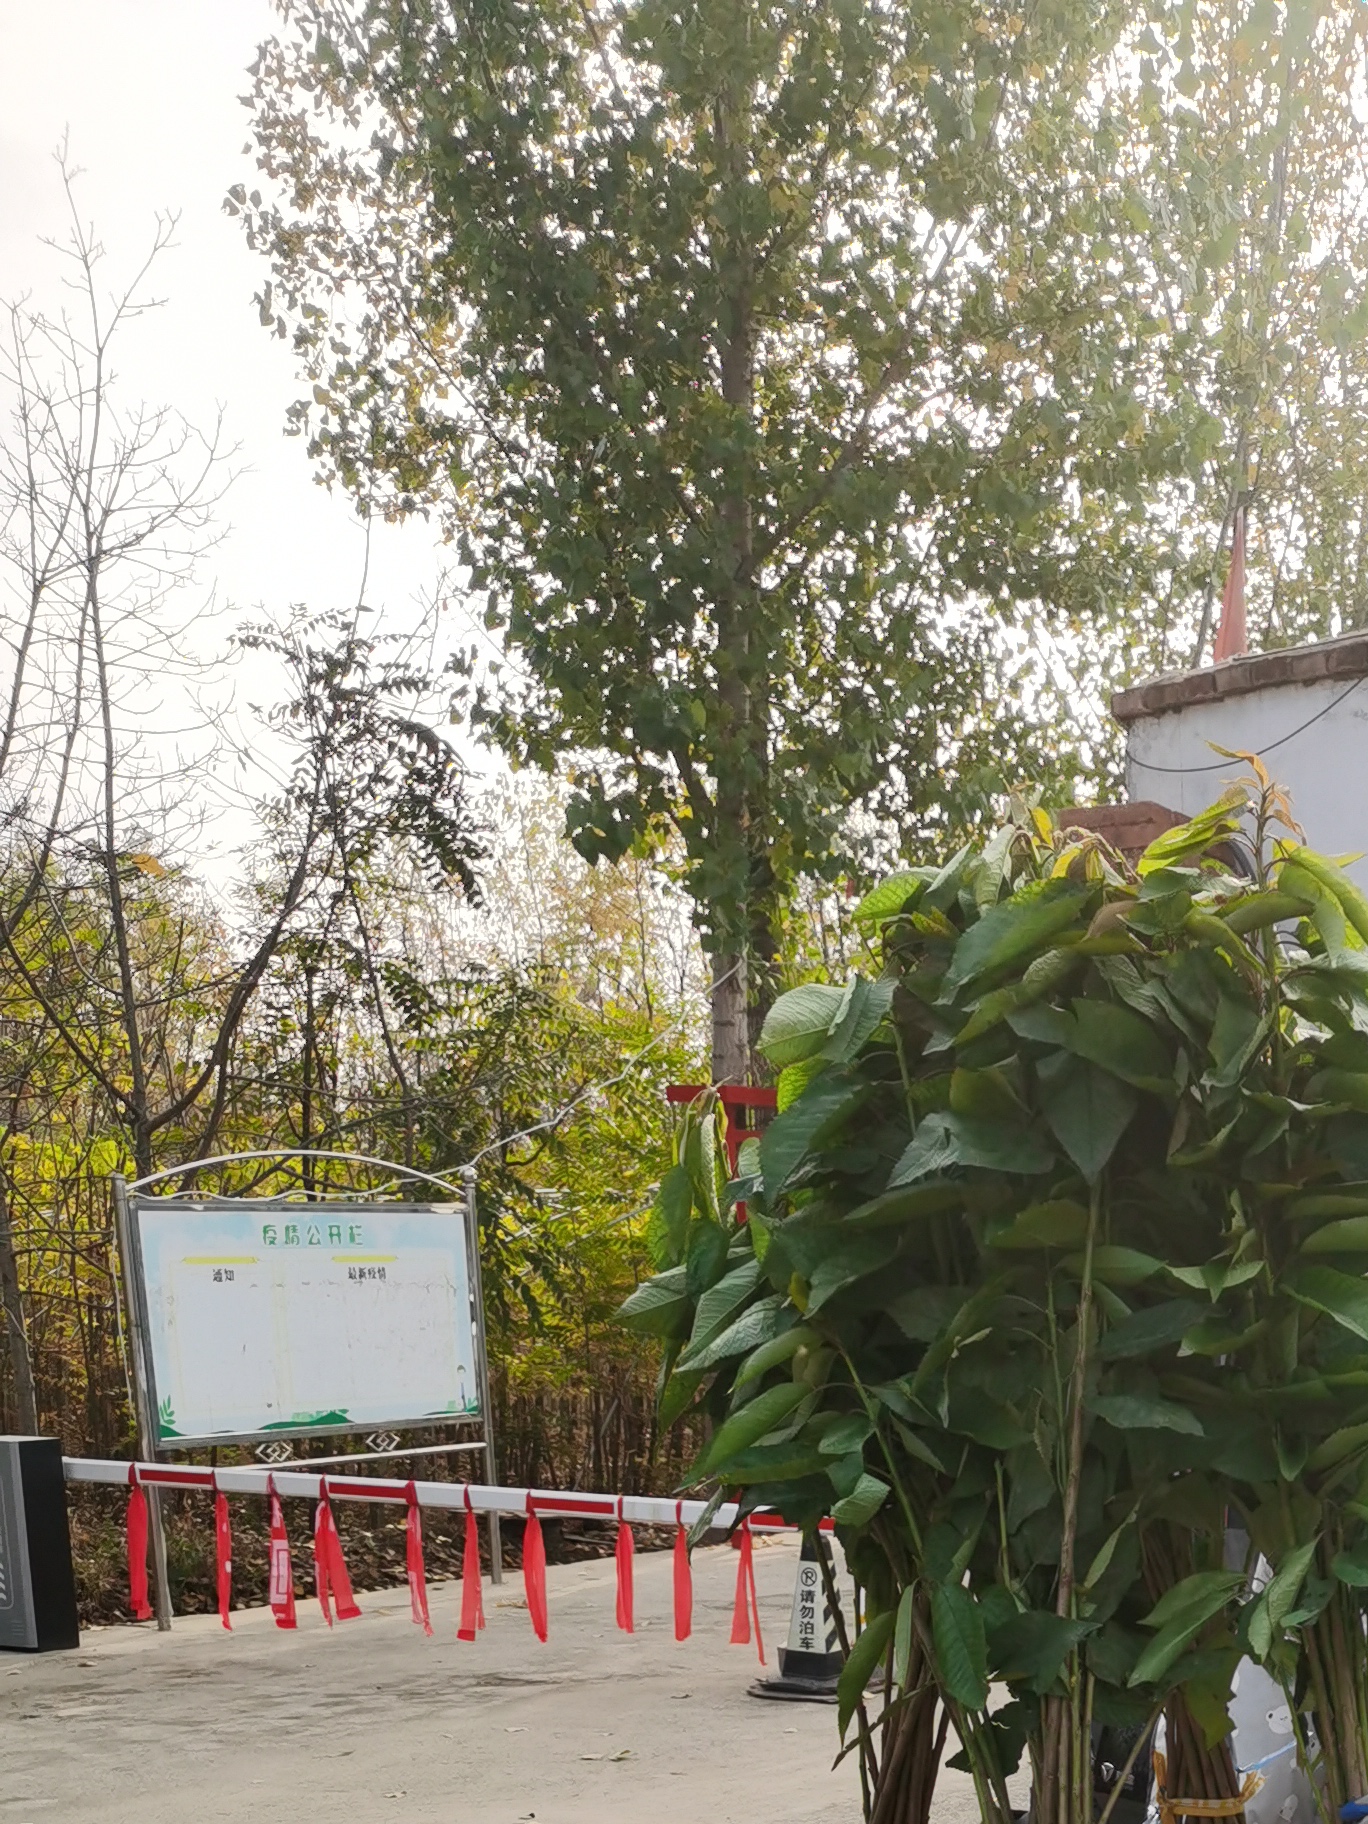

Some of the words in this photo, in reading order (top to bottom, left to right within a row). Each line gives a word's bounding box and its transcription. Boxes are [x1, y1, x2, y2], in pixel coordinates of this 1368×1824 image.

[262, 1224, 364, 1246] 疫情公开栏
[799, 1589, 816, 1650] 请勿泊车
